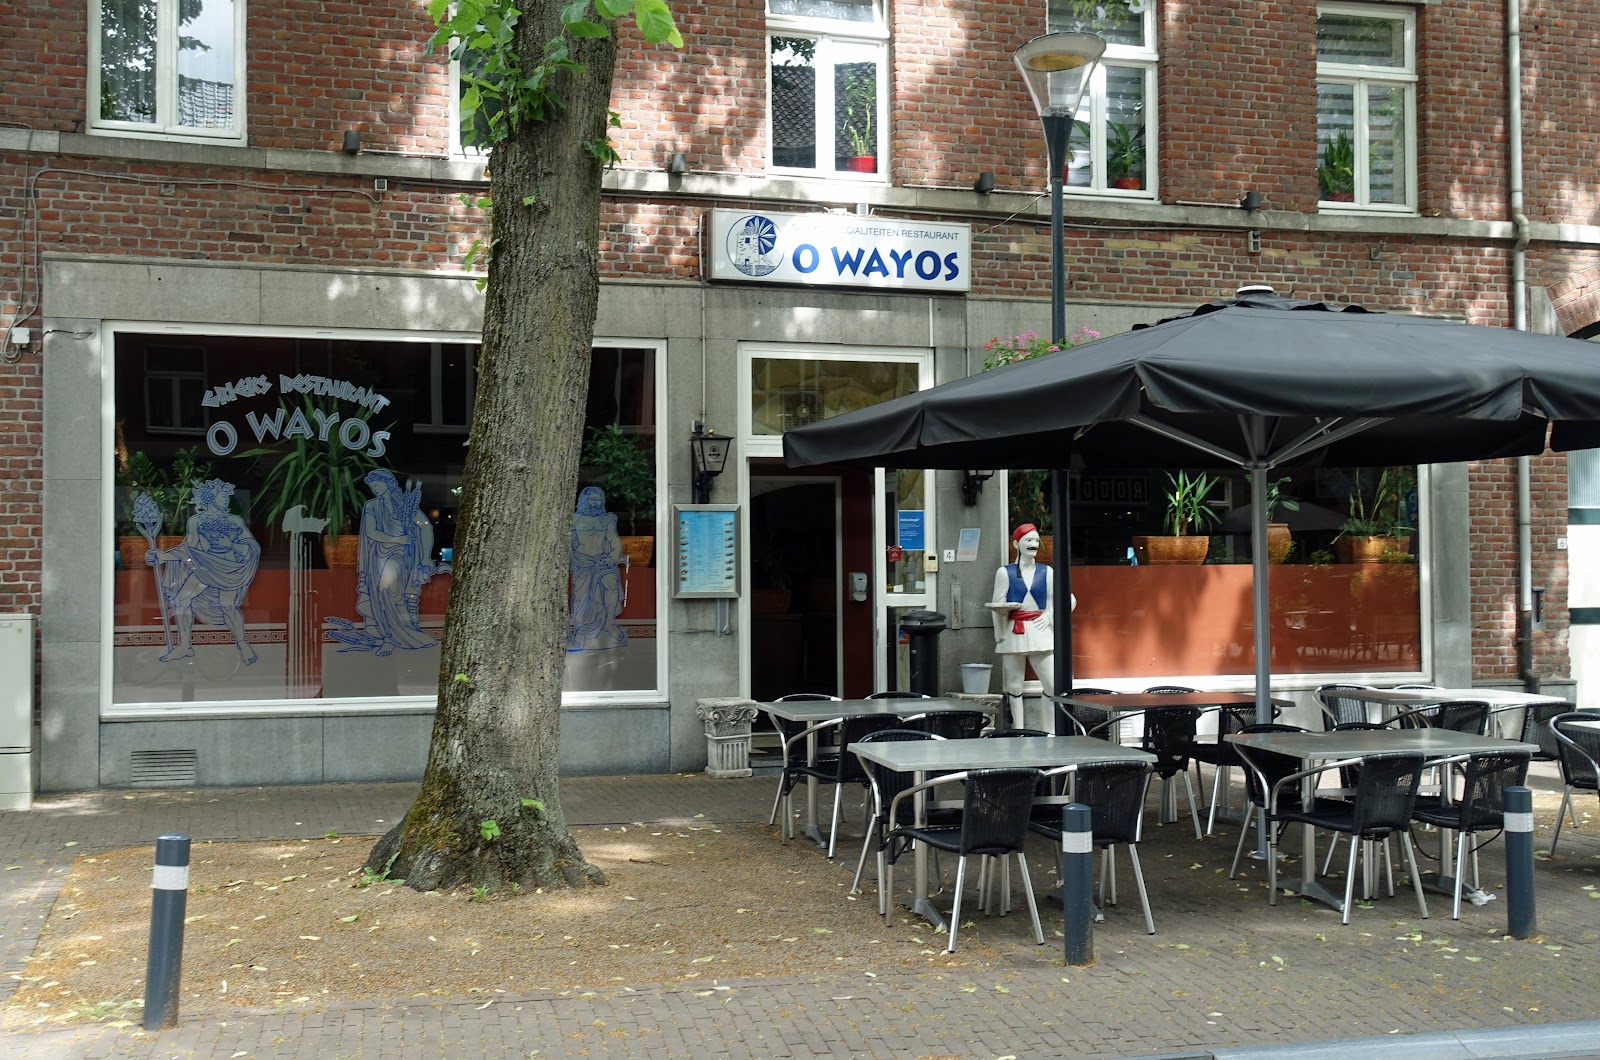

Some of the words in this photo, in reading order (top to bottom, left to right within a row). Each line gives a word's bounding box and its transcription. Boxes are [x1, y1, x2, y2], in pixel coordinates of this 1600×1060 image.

[901, 229, 959, 240] RESTAURANT
[792, 243, 820, 274] O
[831, 246, 959, 281] WAYOS
[201, 374, 273, 408] GRIEKS
[279, 373, 391, 415] RESTAURANT
[206, 420, 238, 456] O
[245, 406, 391, 458] WAYOS
